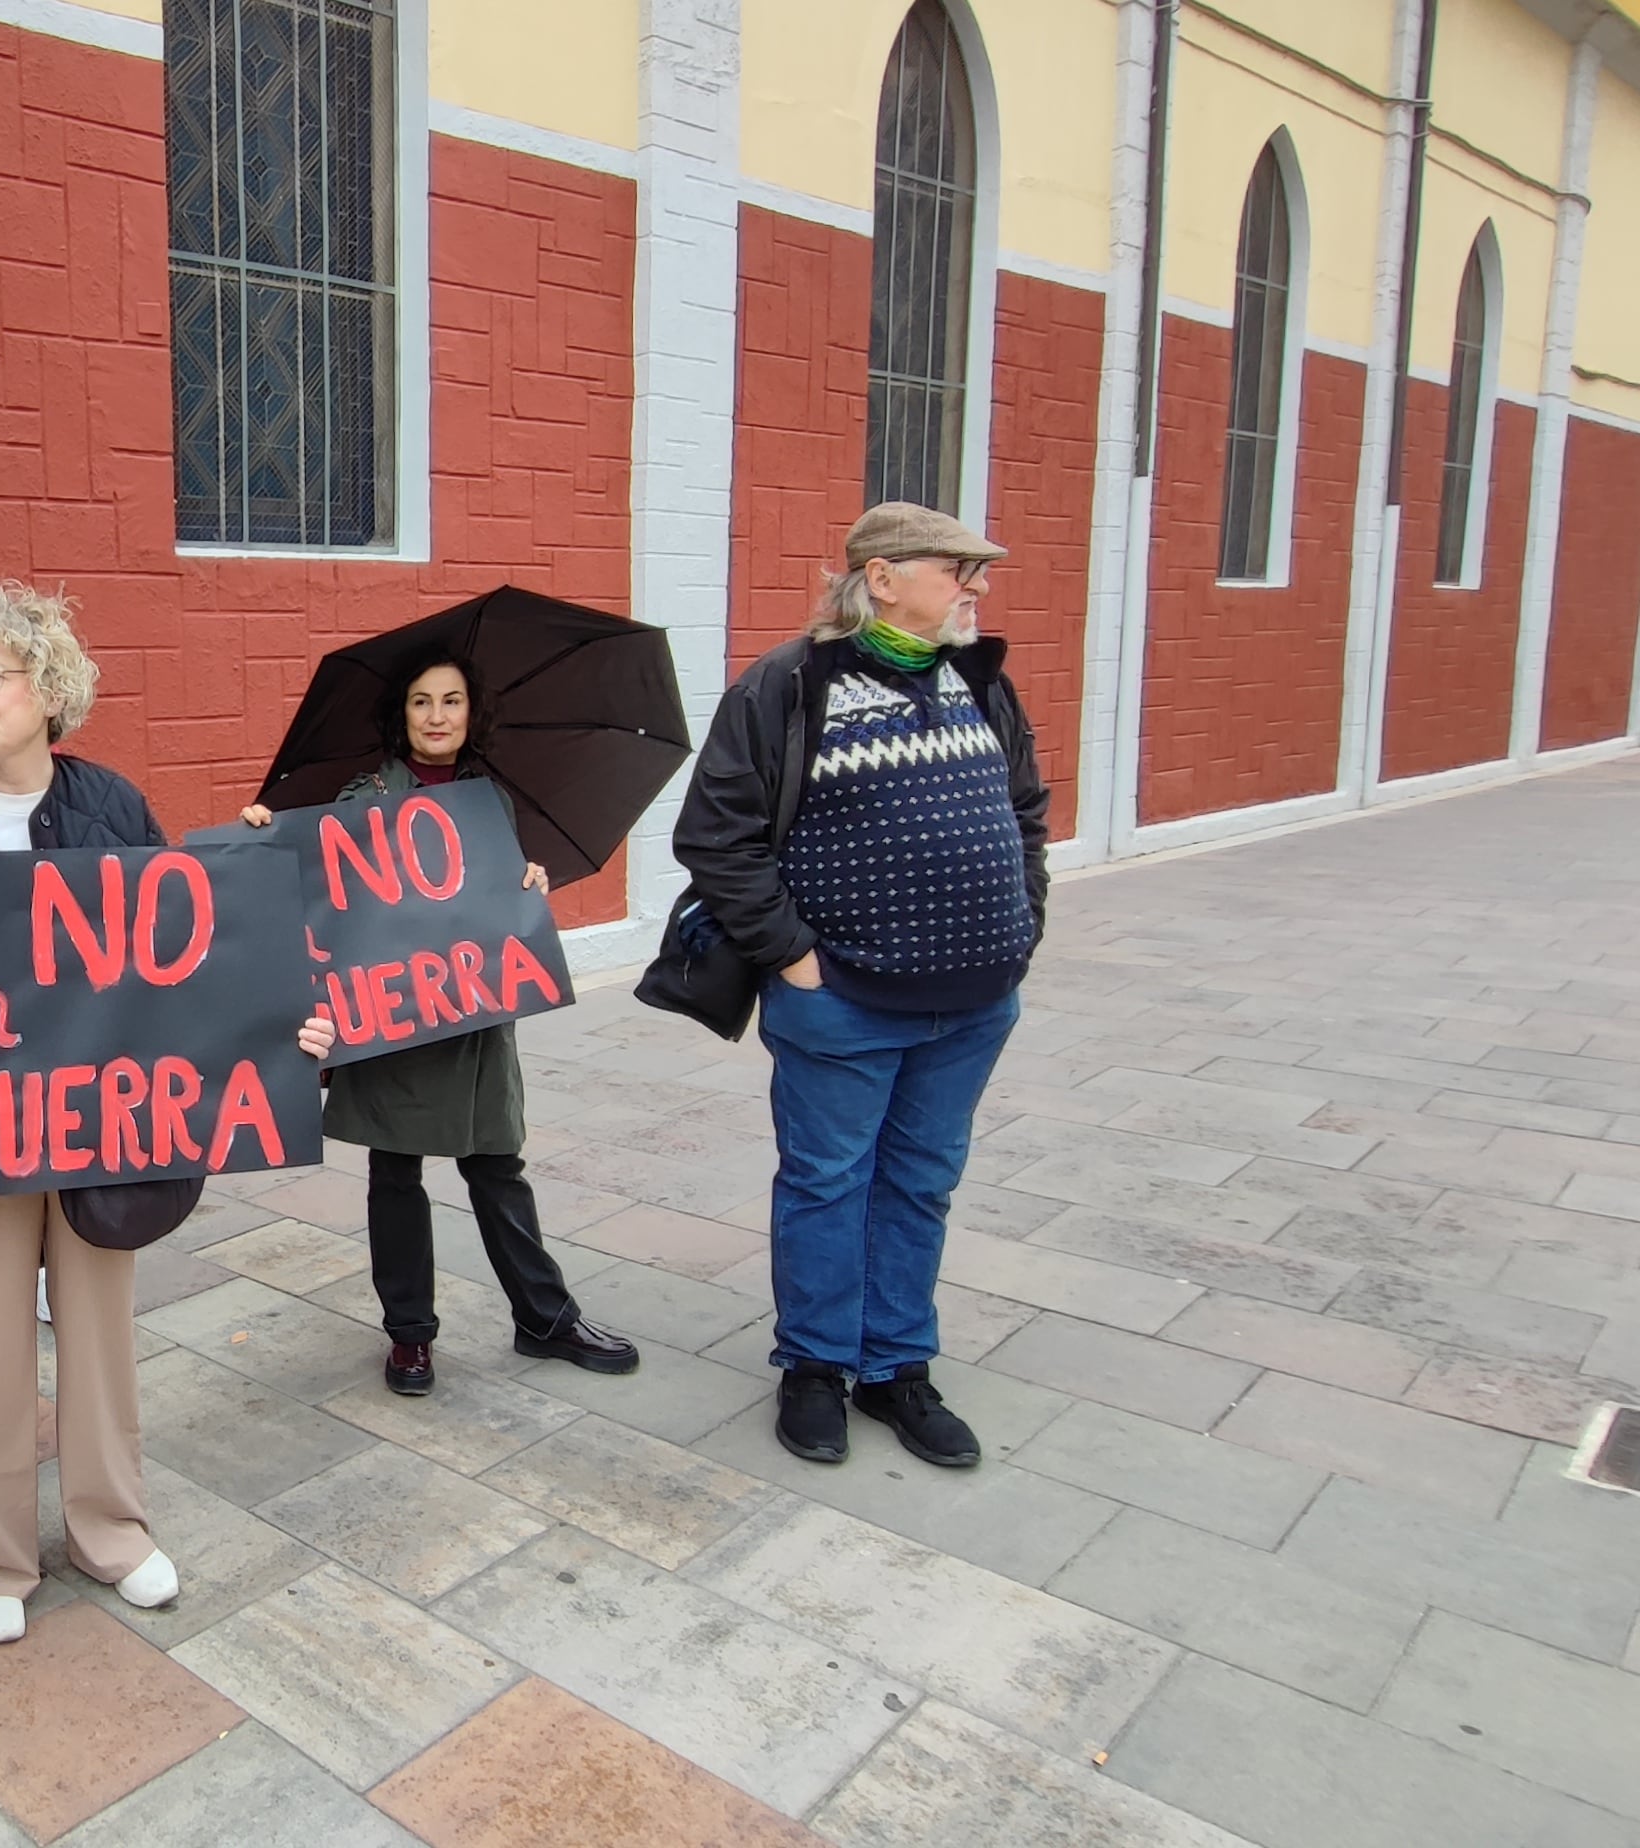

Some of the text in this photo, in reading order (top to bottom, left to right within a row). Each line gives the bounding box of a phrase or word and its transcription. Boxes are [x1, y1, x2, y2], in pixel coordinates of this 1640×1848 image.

[318, 796, 464, 911] NO
[31, 851, 215, 993] NO
[312, 934, 561, 1045] UERRA
